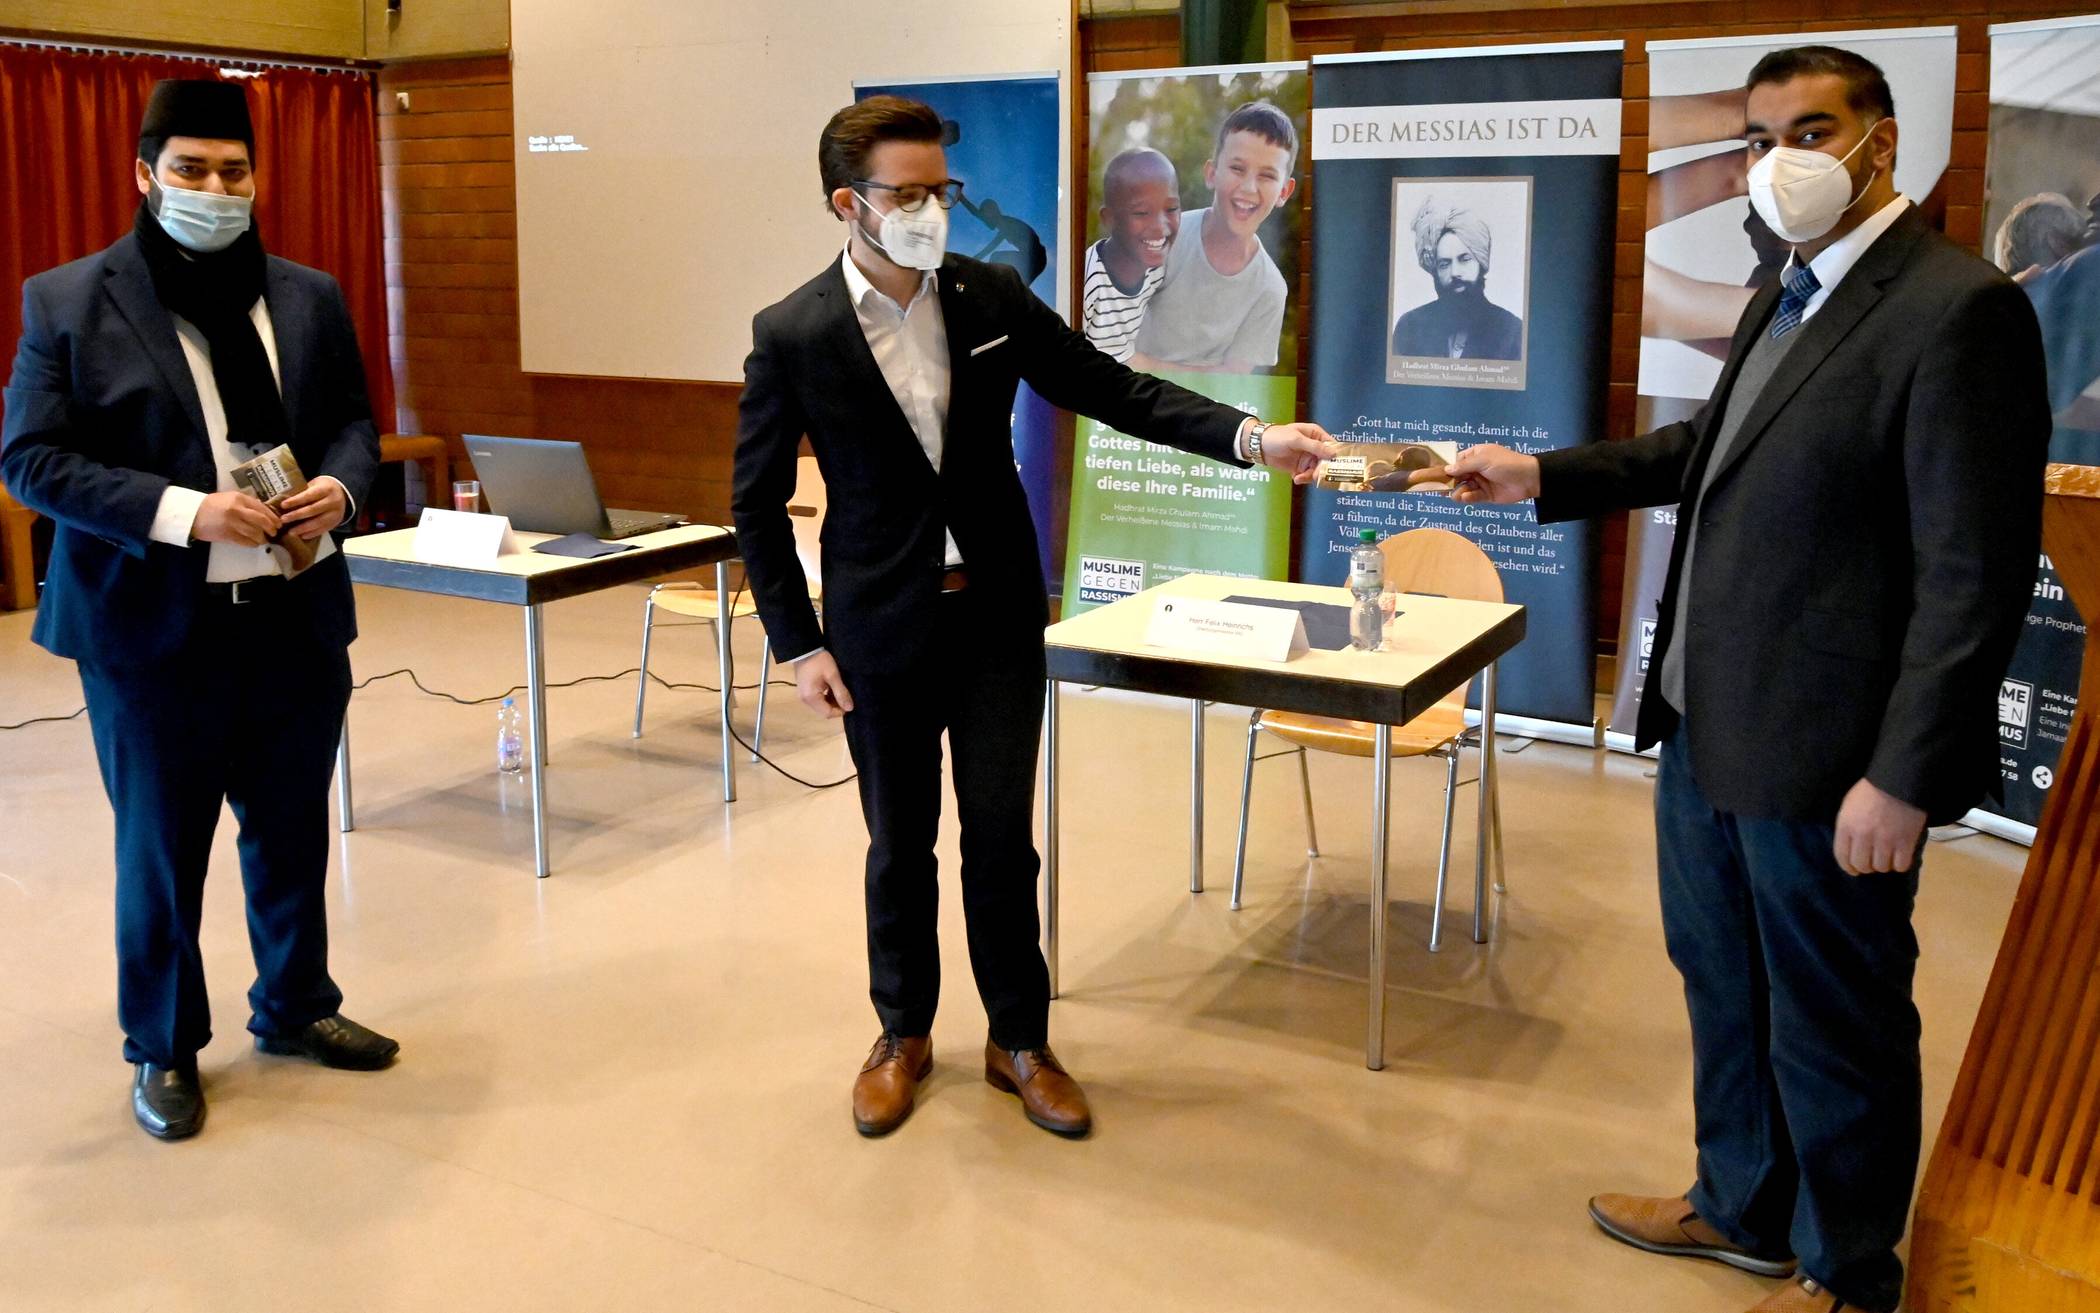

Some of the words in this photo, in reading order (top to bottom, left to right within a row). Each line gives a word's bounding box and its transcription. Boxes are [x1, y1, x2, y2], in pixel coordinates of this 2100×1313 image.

[1332, 122, 1383, 144] DER
[1389, 119, 1497, 142] MESSIAS
[1507, 118, 1549, 140] IST
[1558, 116, 1599, 139] DA
[1385, 418, 1401, 429] hat
[1404, 420, 1429, 431] mich
[1432, 422, 1475, 436] gesandt,
[1477, 424, 1509, 436] damit
[1512, 424, 1529, 437] ich
[1532, 425, 1549, 439] die
[1088, 435, 1141, 450] Gottes
[1085, 454, 1132, 471] tiefen
[1137, 458, 1186, 478] Liebe,
[1190, 462, 1214, 477] als
[1097, 476, 1141, 492] diese
[1146, 479, 1177, 495] Ihre
[1182, 483, 1255, 502] Familie.“
[1336, 496, 1373, 508] stärken
[1375, 498, 1395, 509] und
[1398, 499, 1414, 511] die
[1417, 500, 1461, 515] Existenz
[1463, 504, 1500, 519] Gottes
[1503, 511, 1521, 521] vor
[1100, 513, 1115, 521] Der
[1332, 512, 1344, 521] zu
[1347, 511, 1383, 525] führen,
[1385, 514, 1397, 525] da
[1400, 516, 1416, 527] der
[1465, 521, 1483, 533] des
[1486, 523, 1537, 539] Glaubens
[1540, 529, 1564, 542] aller
[1497, 542, 1510, 553] ist
[1513, 544, 1535, 556] und
[1537, 546, 1556, 558] das
[1083, 561, 1142, 576] MUSLIME
[1082, 574, 1140, 590] GEGEN
[2042, 689, 2062, 702] Eine
[2039, 715, 2058, 727] Eine
